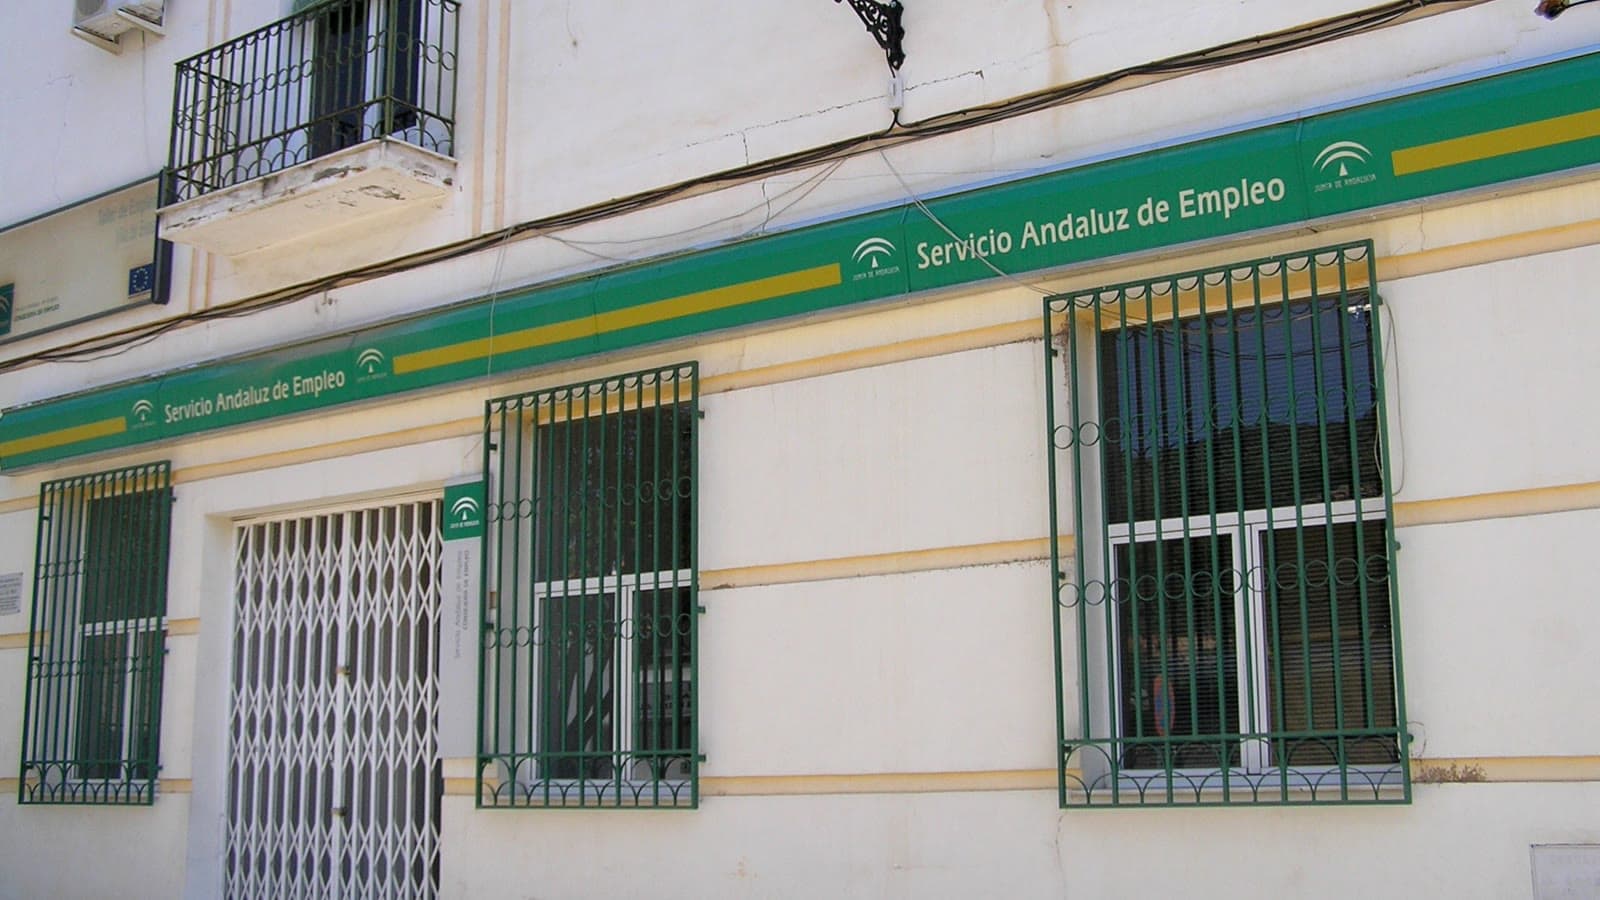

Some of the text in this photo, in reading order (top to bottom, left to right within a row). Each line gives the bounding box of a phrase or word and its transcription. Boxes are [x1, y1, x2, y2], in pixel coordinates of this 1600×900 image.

[917, 177, 1285, 269] Servicio Andaluz de Empleo
[165, 397, 212, 423] Servicio
[216, 386, 270, 412] Andaluz
[272, 381, 289, 400] de
[293, 370, 345, 397] Empleo
